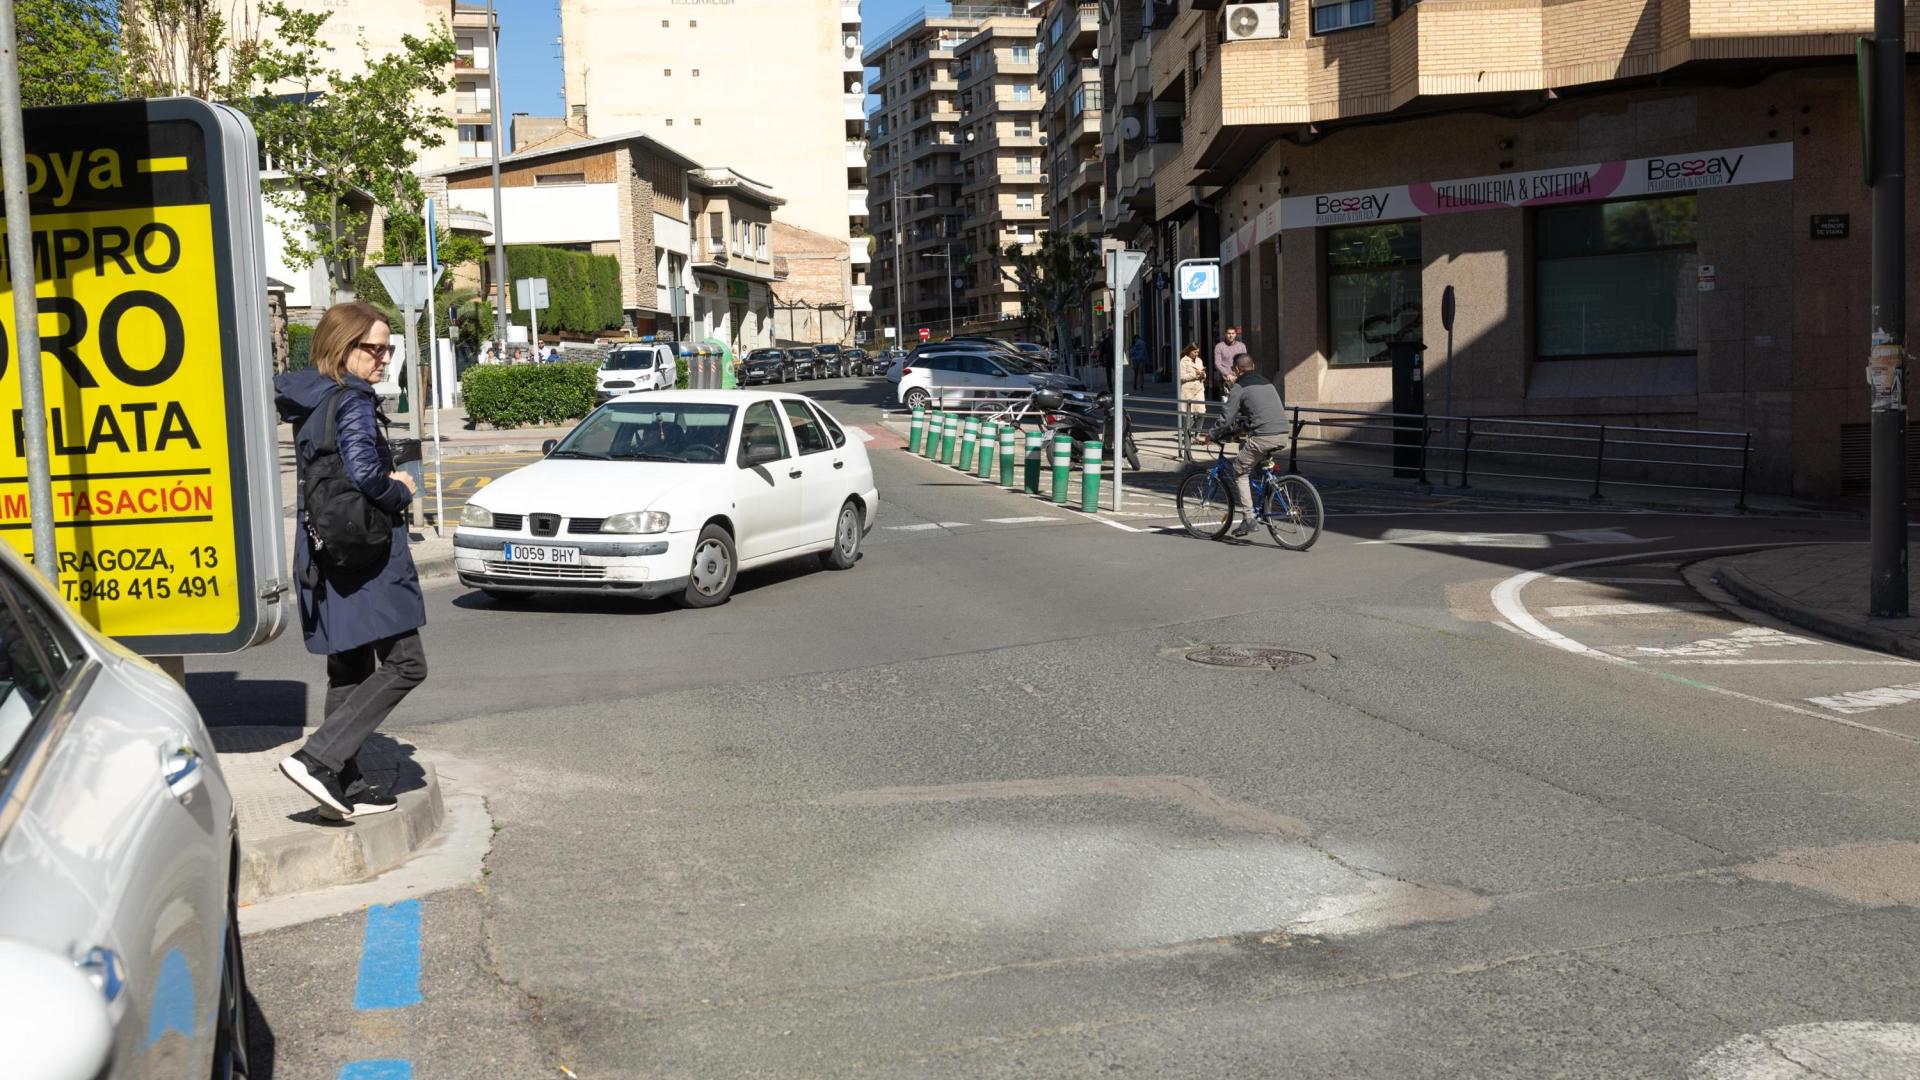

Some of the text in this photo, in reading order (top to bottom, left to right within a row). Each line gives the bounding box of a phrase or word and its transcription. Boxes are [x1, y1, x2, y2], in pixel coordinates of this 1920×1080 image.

[0, 148, 123, 206] oya
[1647, 154, 1744, 184] Bessay
[1315, 193, 1390, 219] Bessay
[1437, 171, 1592, 208] PELUQUERIA & ESTETICA
[0, 222, 181, 282] MPRO
[0, 290, 185, 389] RO
[57, 480, 212, 518] TASACIÓN
[24, 545, 219, 573] RAGOZA, 13
[514, 546, 574, 562] 0059 BHY
[127, 577, 171, 600] 415
[178, 575, 220, 598] 491
